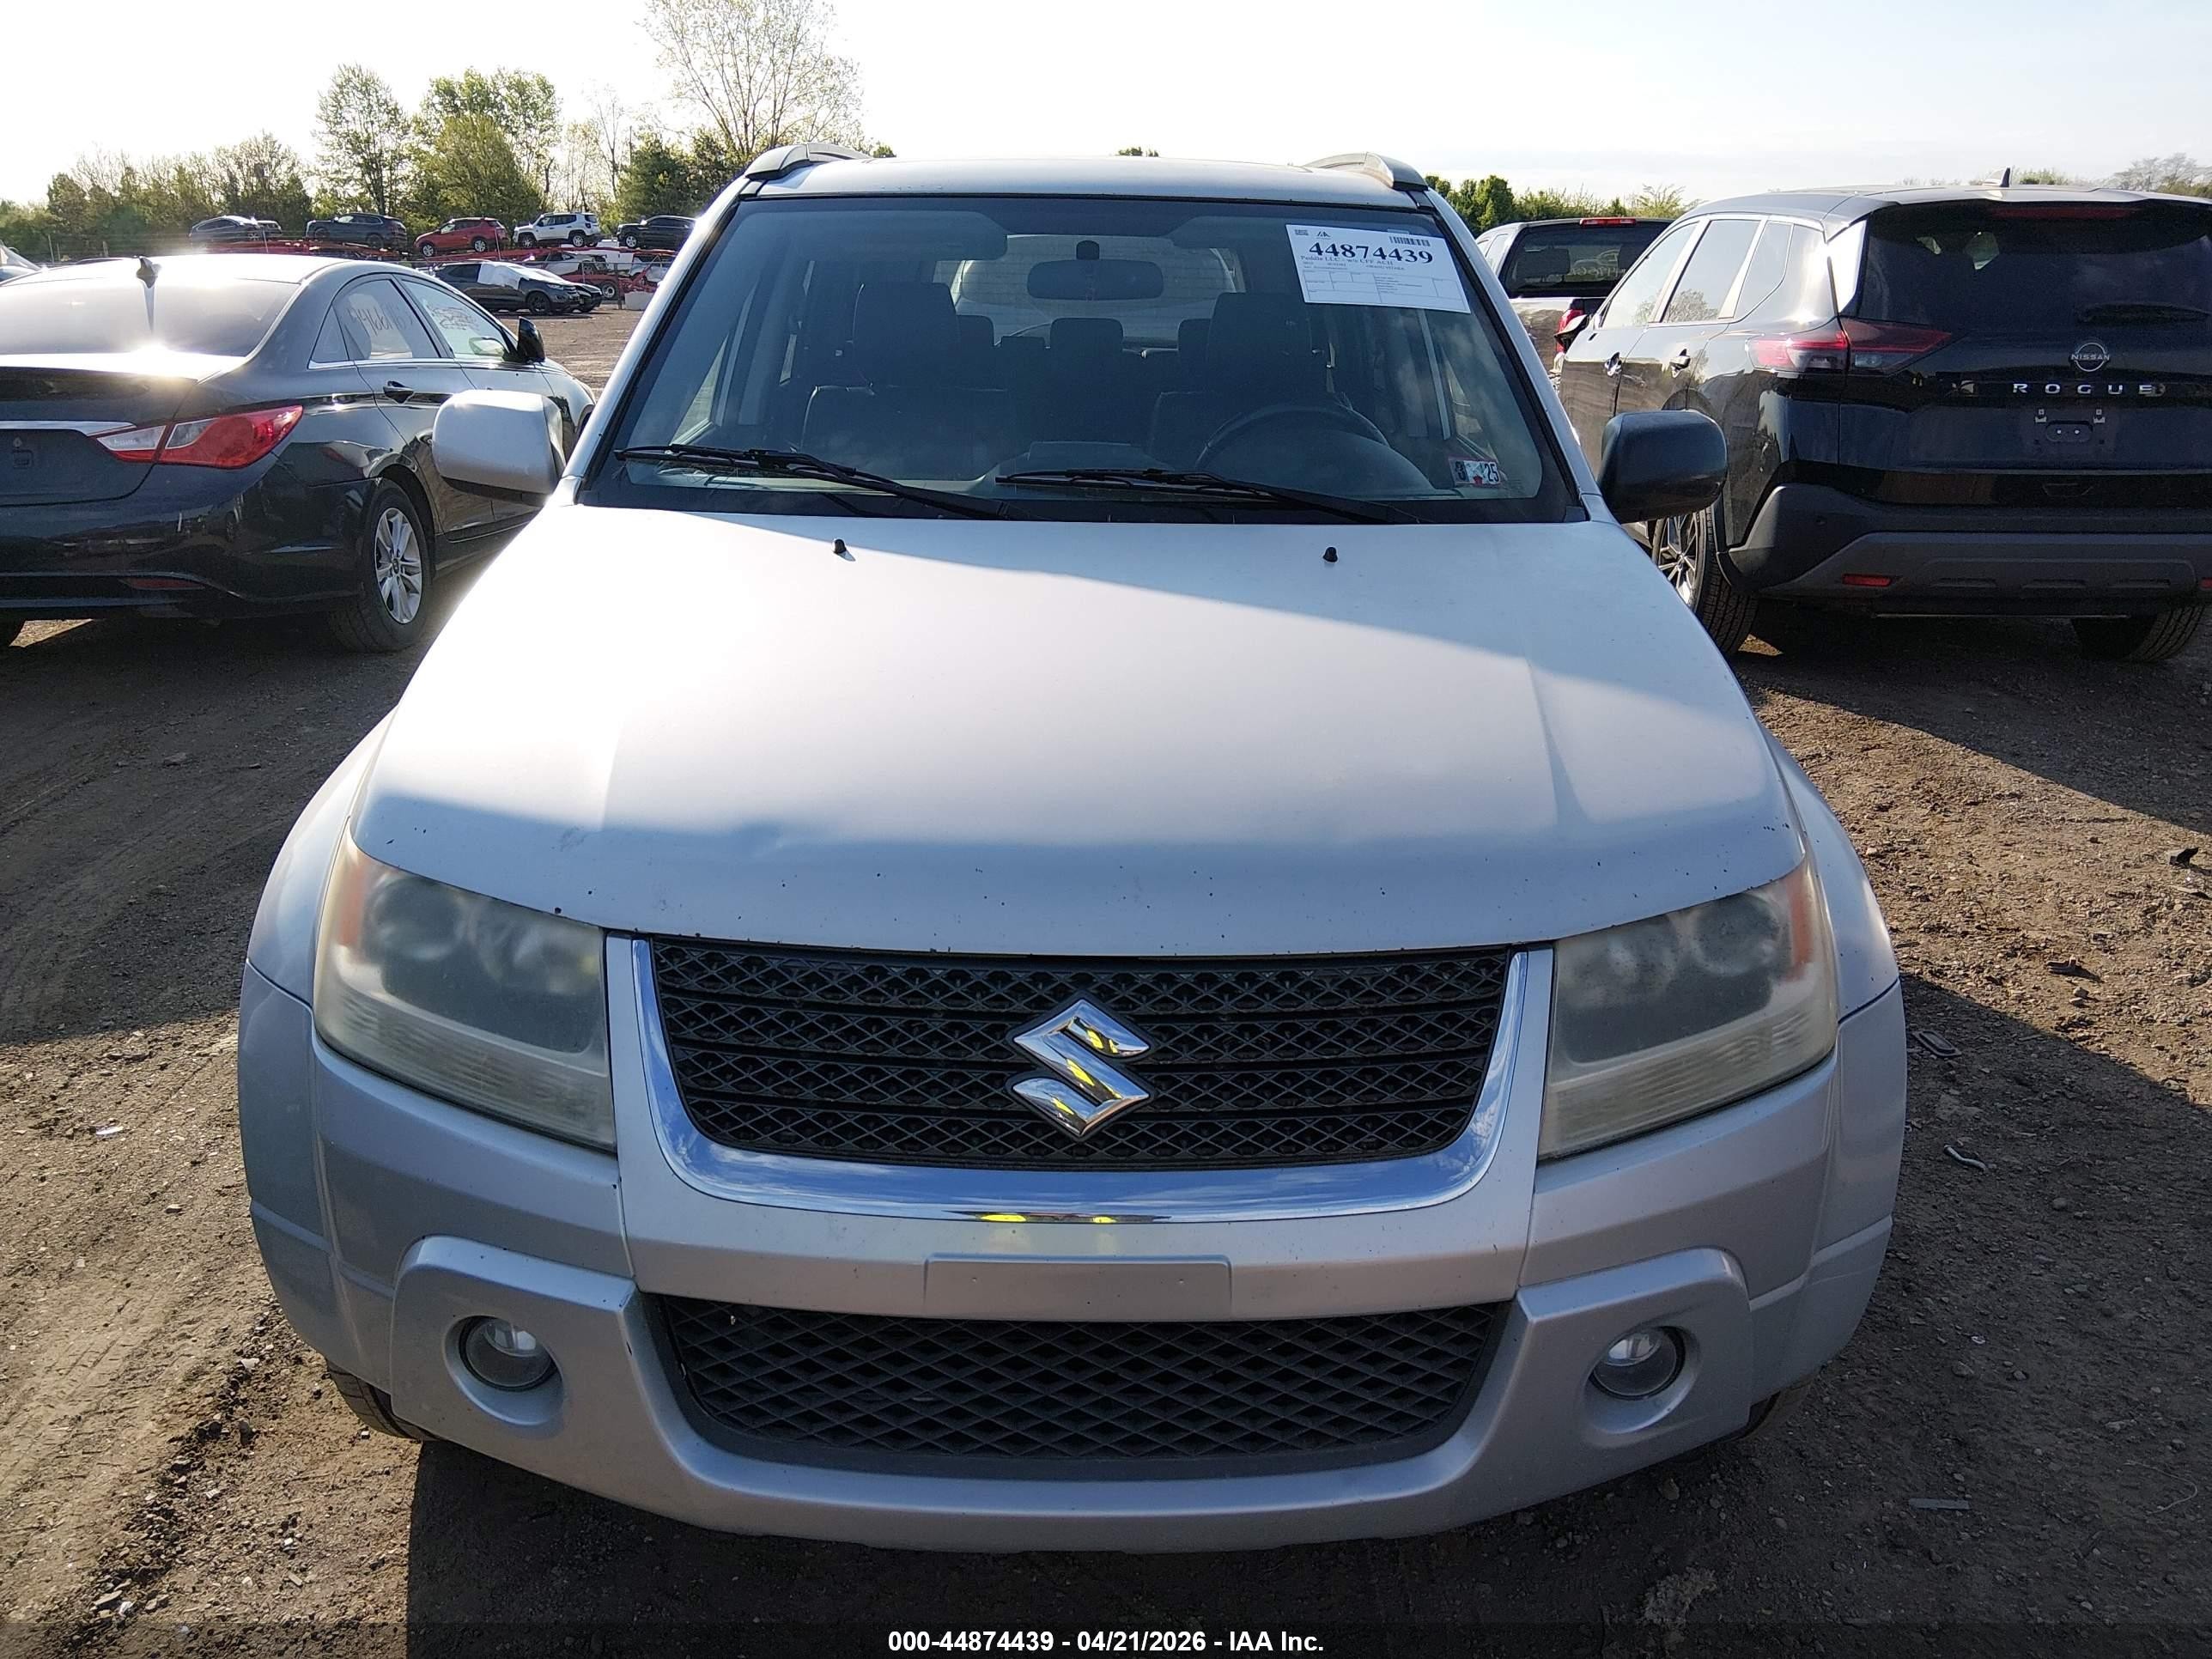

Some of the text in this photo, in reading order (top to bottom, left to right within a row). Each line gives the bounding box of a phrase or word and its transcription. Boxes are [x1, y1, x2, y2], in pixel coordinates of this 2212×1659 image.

[1310, 242, 1433, 264] 44874439
[2013, 383, 2154, 395] ROGUE
[1484, 463, 1499, 482] 25
